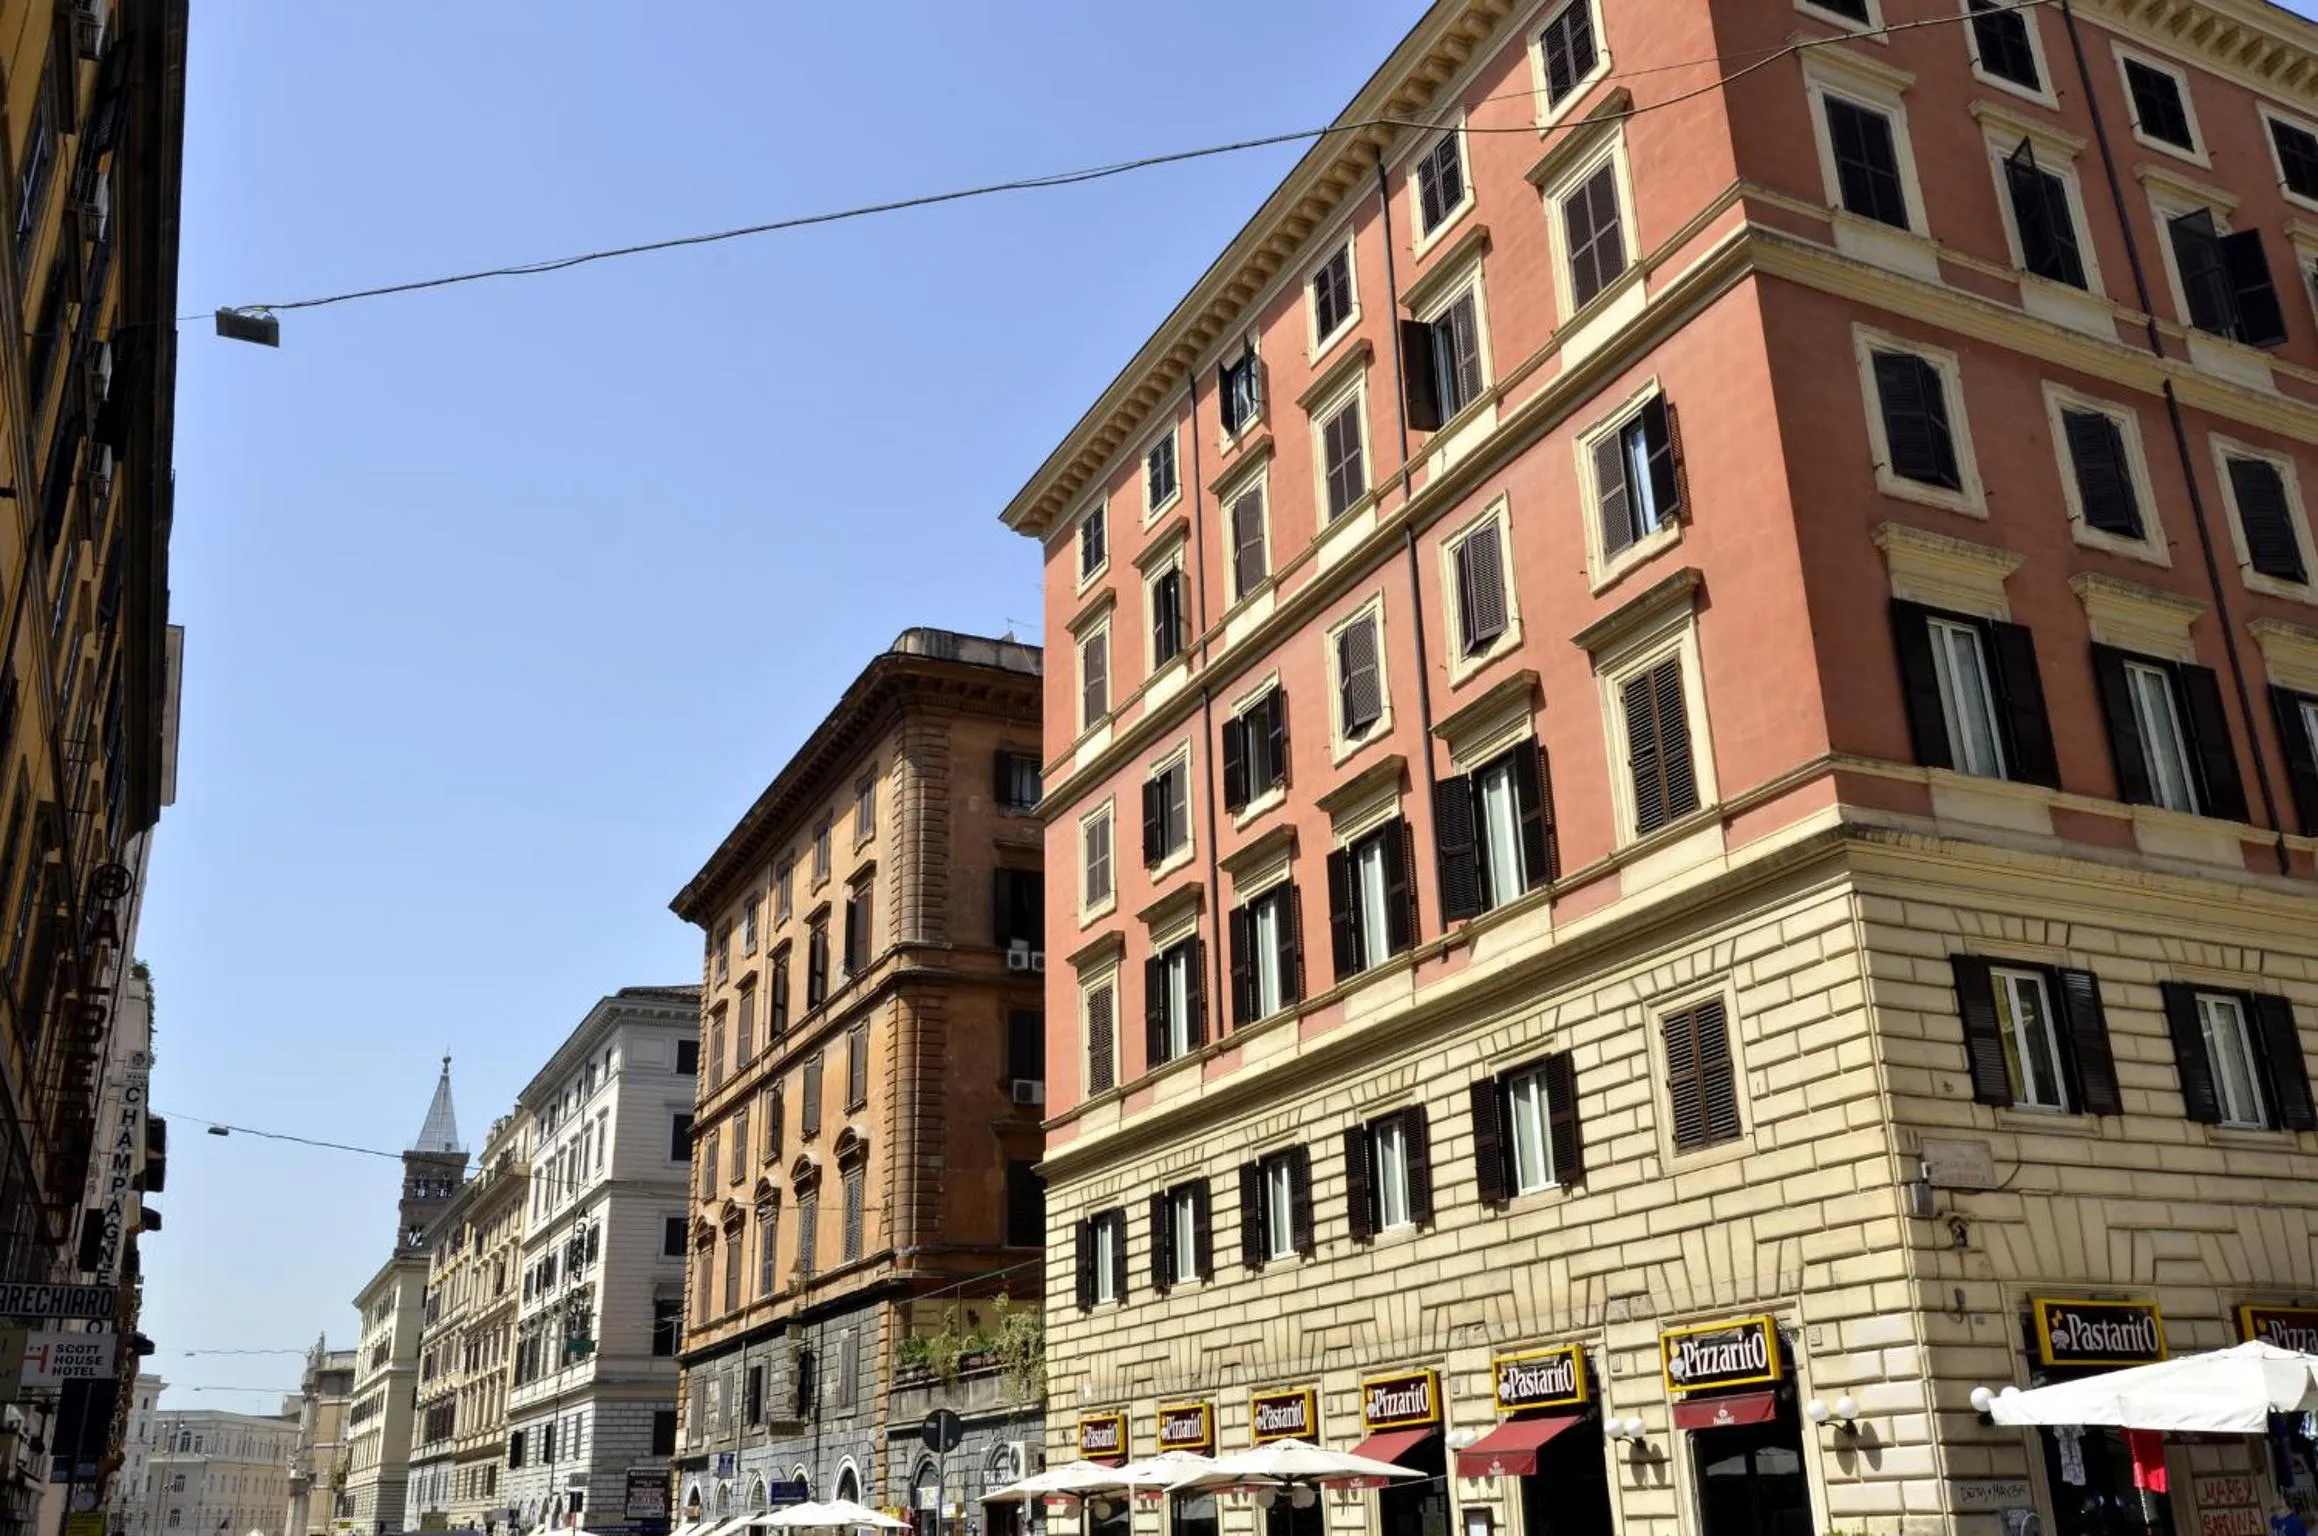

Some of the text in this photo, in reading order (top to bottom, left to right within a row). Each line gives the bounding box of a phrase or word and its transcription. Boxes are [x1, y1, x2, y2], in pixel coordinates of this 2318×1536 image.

[95, 1087, 141, 1287] CHAMPAGNE
[55, 1343, 101, 1354] SCOTT
[54, 1355, 104, 1366] HOUSE
[52, 1366, 97, 1377] HOTEL
